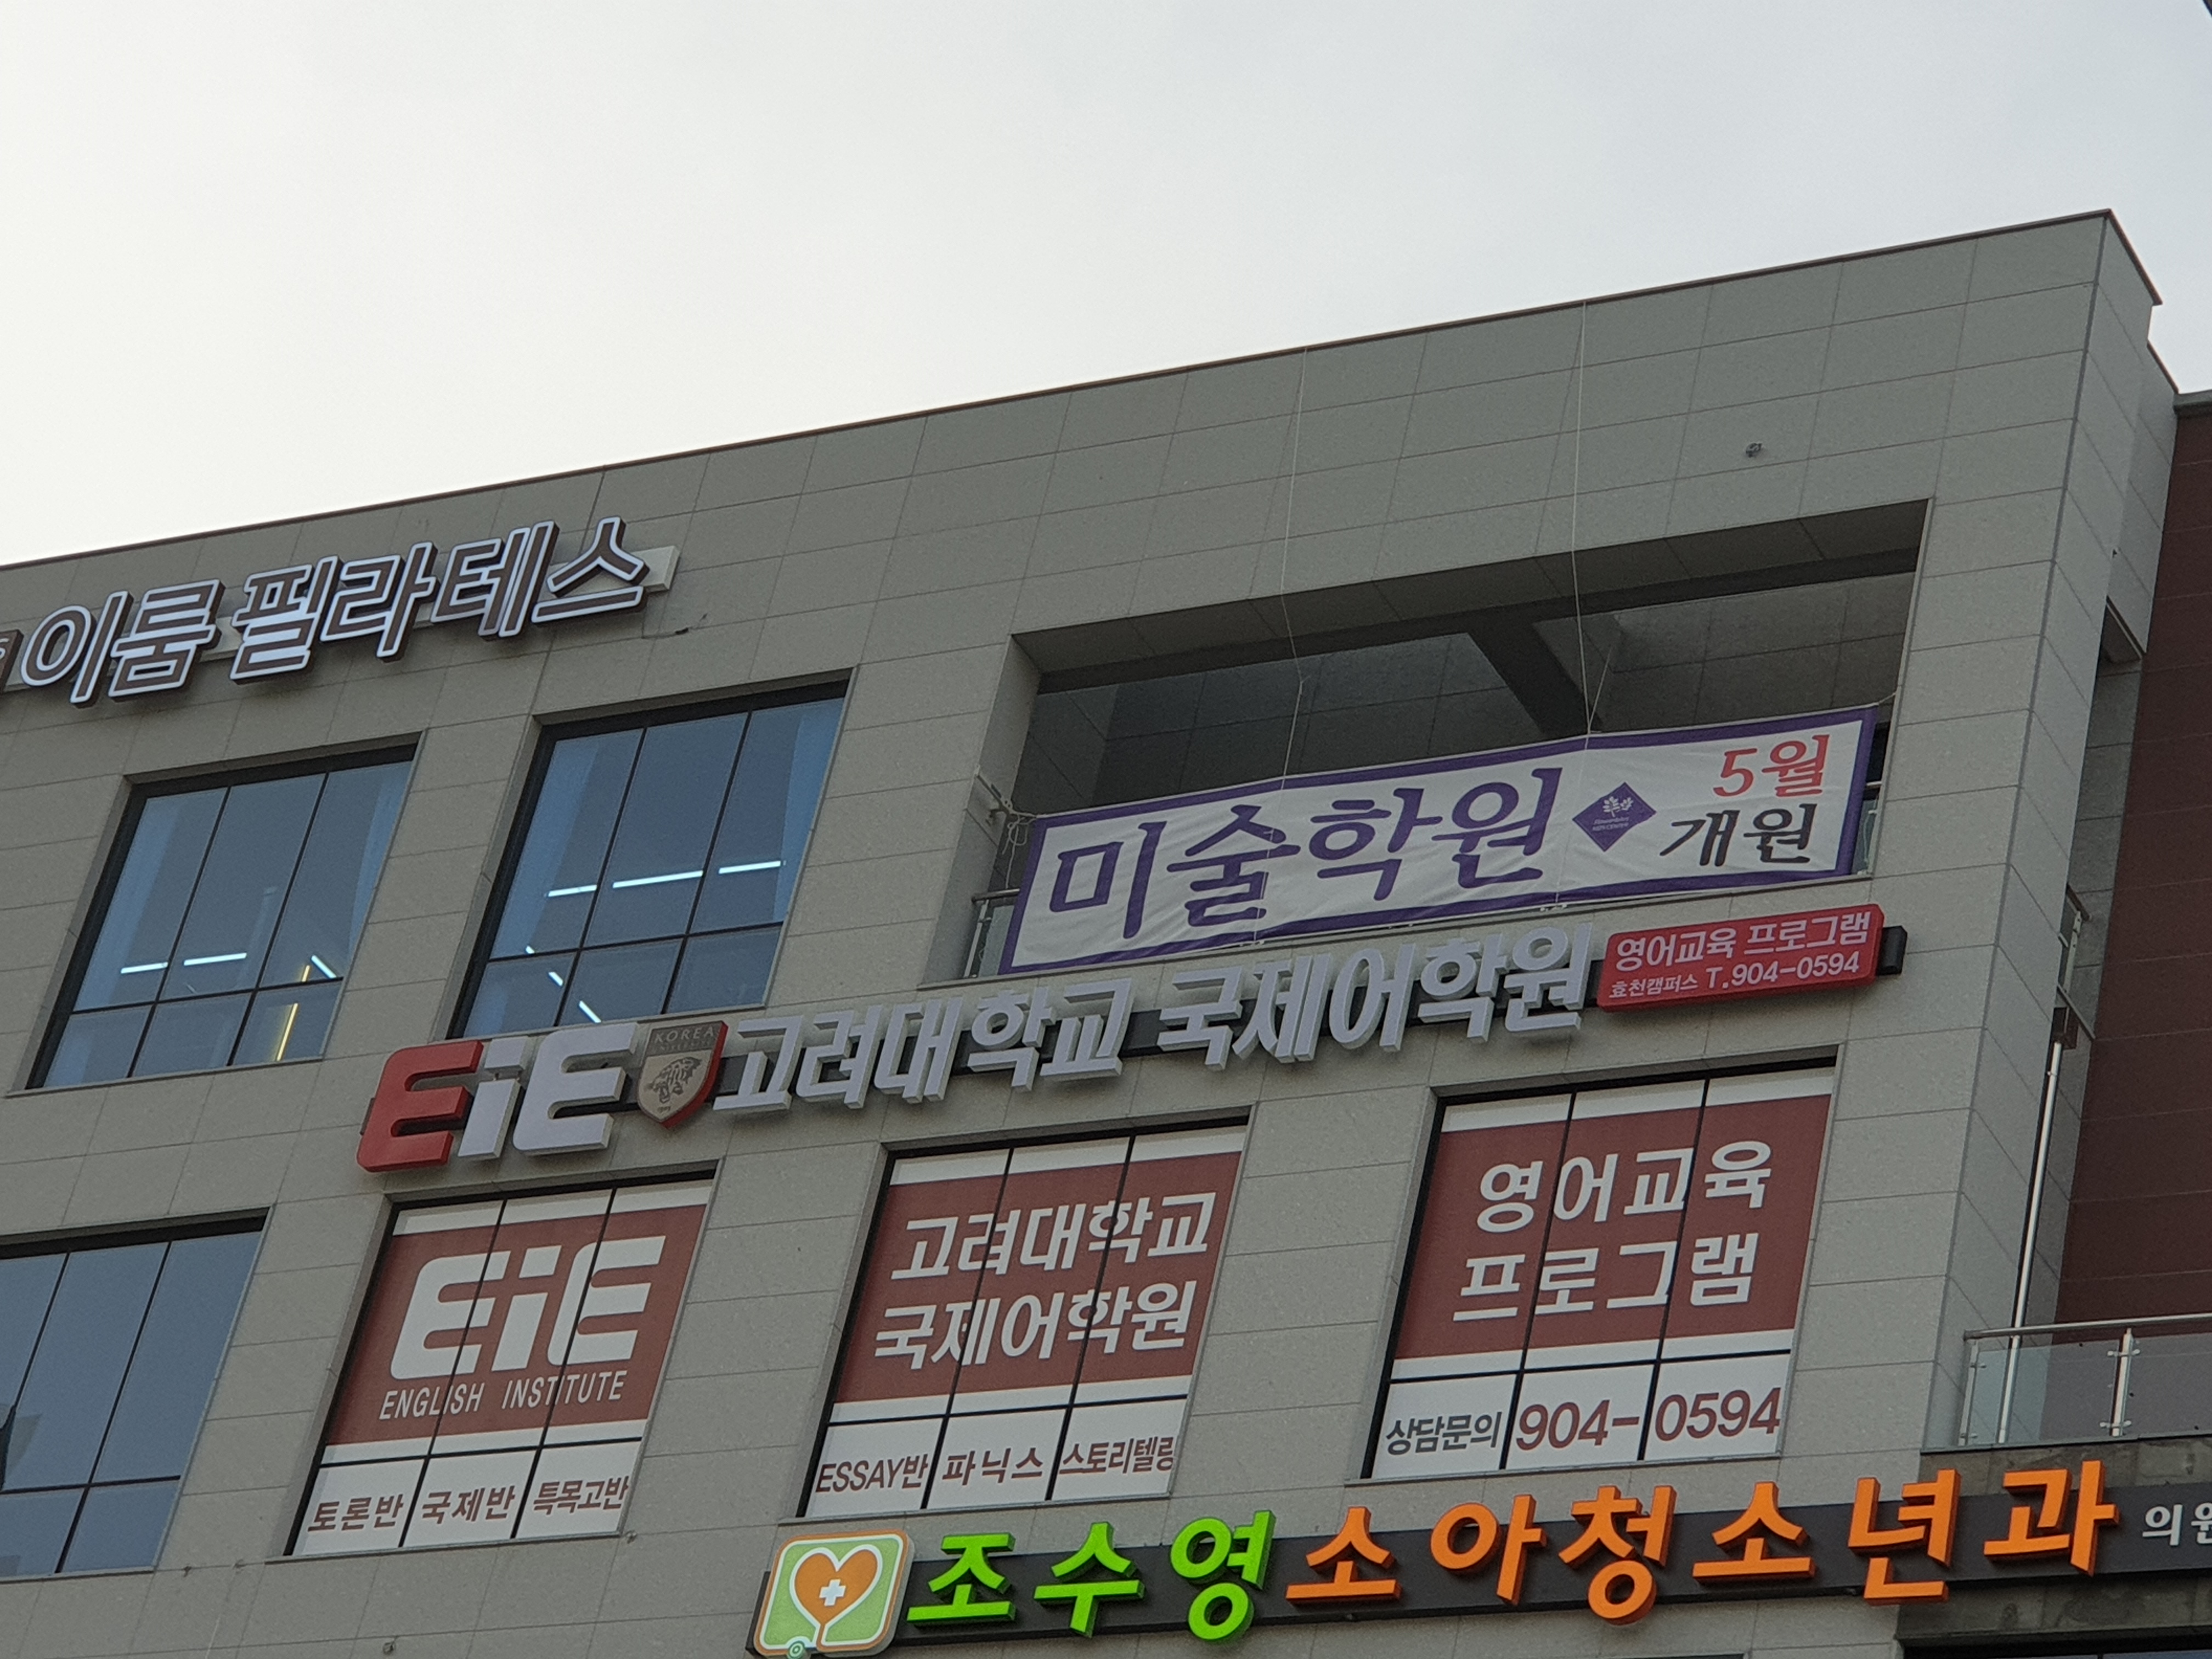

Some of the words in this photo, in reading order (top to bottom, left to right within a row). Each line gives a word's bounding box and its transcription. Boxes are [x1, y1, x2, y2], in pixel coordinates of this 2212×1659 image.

[21, 580, 223, 704] 이룸
[230, 517, 651, 683] 필라테스
[1713, 735, 1830, 797] 5월
[1049, 768, 1562, 940] 미술학원
[1660, 804, 1817, 866] 개원
[1617, 928, 1736, 972] 영어교육
[1744, 911, 1871, 955] 프로그램
[713, 978, 1134, 1111] 고려대학교
[1157, 922, 1593, 1071] 국제어학원
[1609, 975, 1699, 998] 효천캠퍼스
[654, 1026, 714, 1042] KOREA
[1477, 1140, 1771, 1233] 영어교육
[891, 1192, 1216, 1279] 고려대학교
[1453, 1232, 1759, 1321] 프로그램
[874, 1280, 1197, 1369] 국제어학원
[379, 1383, 484, 1420] ENGLISH
[501, 1370, 627, 1409] INSTITUTE
[1386, 1412, 1502, 1455] 상담문의
[816, 1453, 928, 1493] ESSAY반
[942, 1447, 1043, 1486] 파닉스
[308, 1494, 404, 1531] 토론반
[422, 1486, 515, 1523] 국제반
[534, 1475, 629, 1515] 특목고반
[907, 1510, 1274, 1641] 조수영
[1285, 1459, 2119, 1626] 소아청소년과
